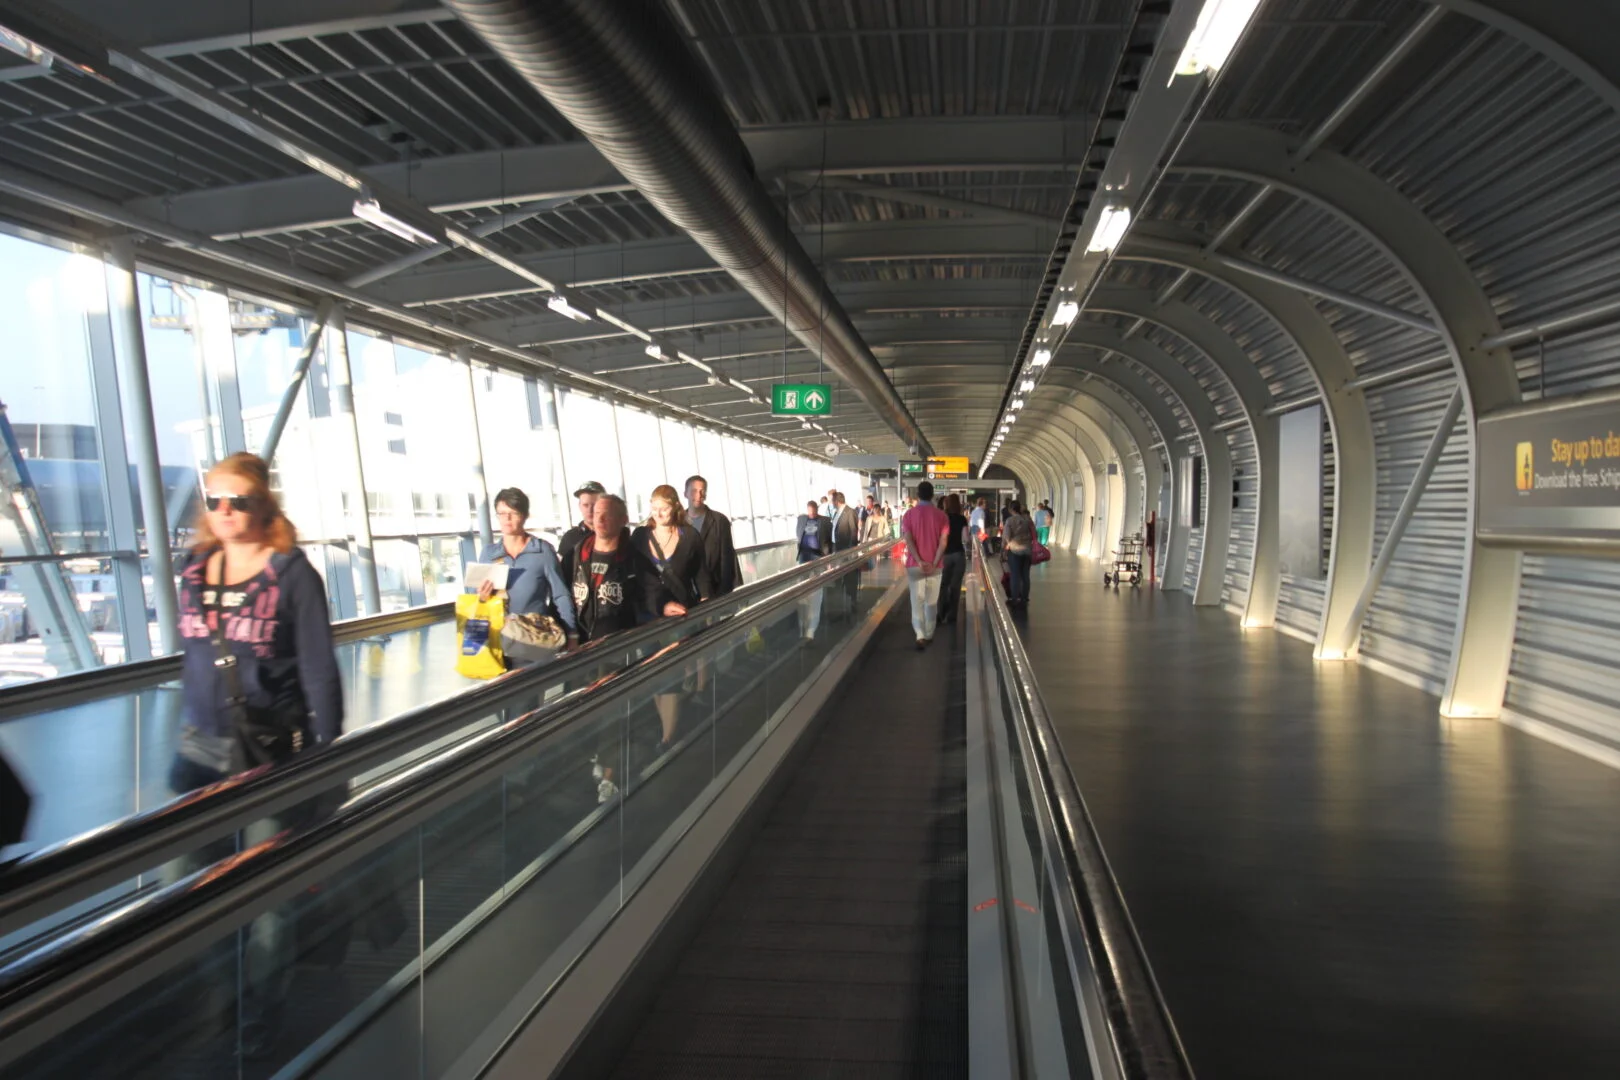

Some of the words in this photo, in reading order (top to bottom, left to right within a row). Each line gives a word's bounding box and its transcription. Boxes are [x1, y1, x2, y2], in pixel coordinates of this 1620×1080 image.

[1552, 438, 1573, 468] Stay
[1575, 441, 1588, 467] up
[1590, 436, 1603, 459] to
[1534, 470, 1568, 489] Download
[1569, 470, 1581, 488] the
[1582, 469, 1598, 488] free
